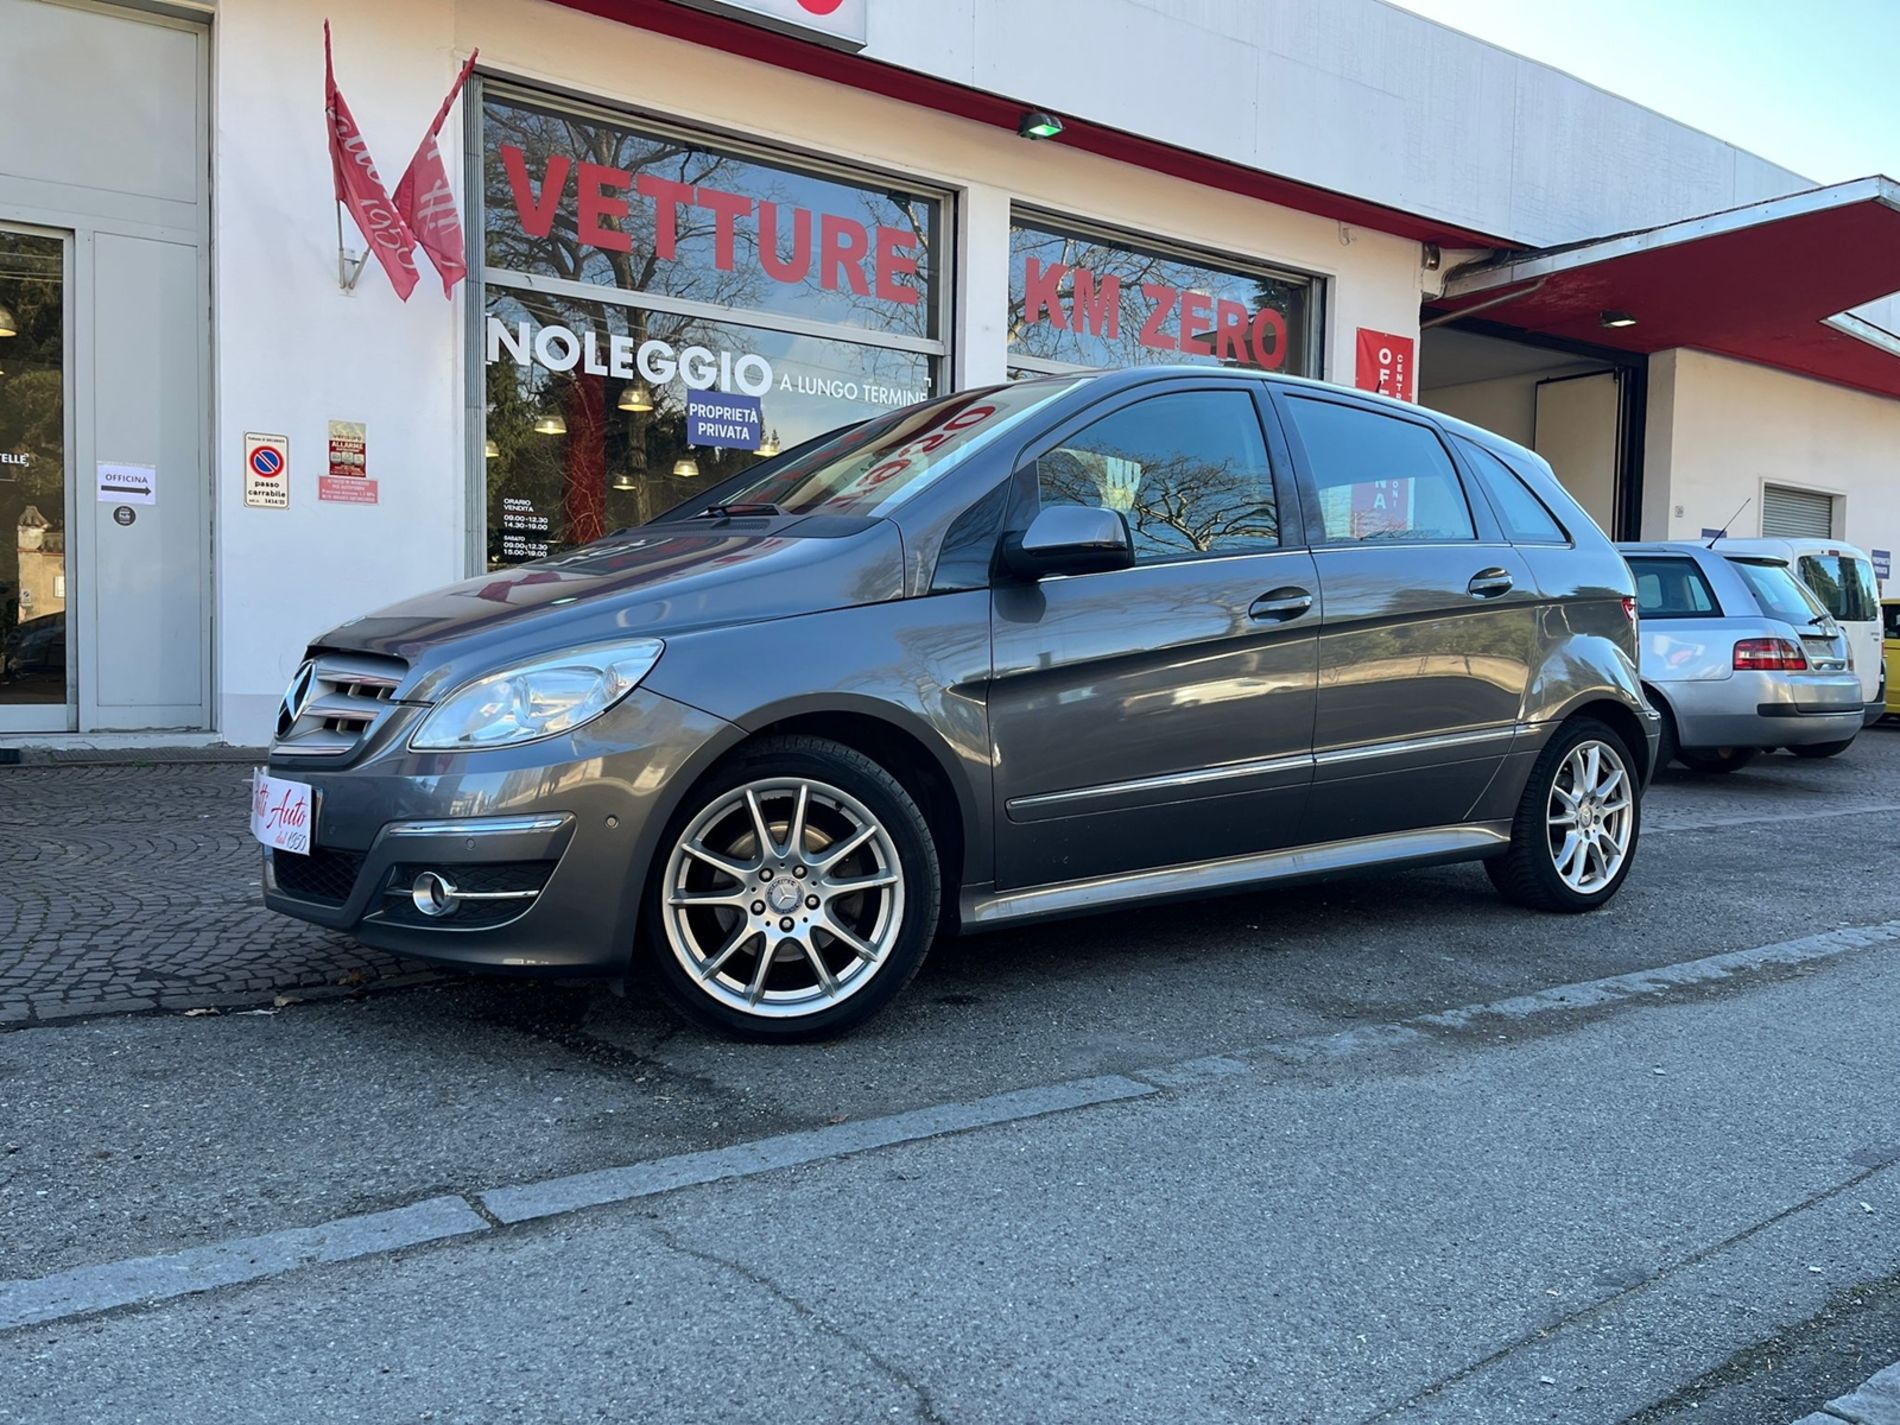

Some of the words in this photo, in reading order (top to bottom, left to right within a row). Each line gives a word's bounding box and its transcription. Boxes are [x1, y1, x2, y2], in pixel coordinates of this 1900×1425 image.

[500, 145, 918, 305] VETTURE
[1025, 256, 1121, 340] KM
[1139, 282, 1288, 370] ZERO
[487, 317, 773, 397] NOLEGGIO
[780, 374, 793, 392] A
[798, 376, 858, 400] LUNGO
[689, 402, 759, 424] PROPRIETÀ
[697, 423, 750, 441] PRIVATA
[0, 453, 27, 465] ELLE
[105, 473, 149, 484] OFFICINA
[247, 489, 286, 498] carrabile
[266, 789, 308, 829] Auto
